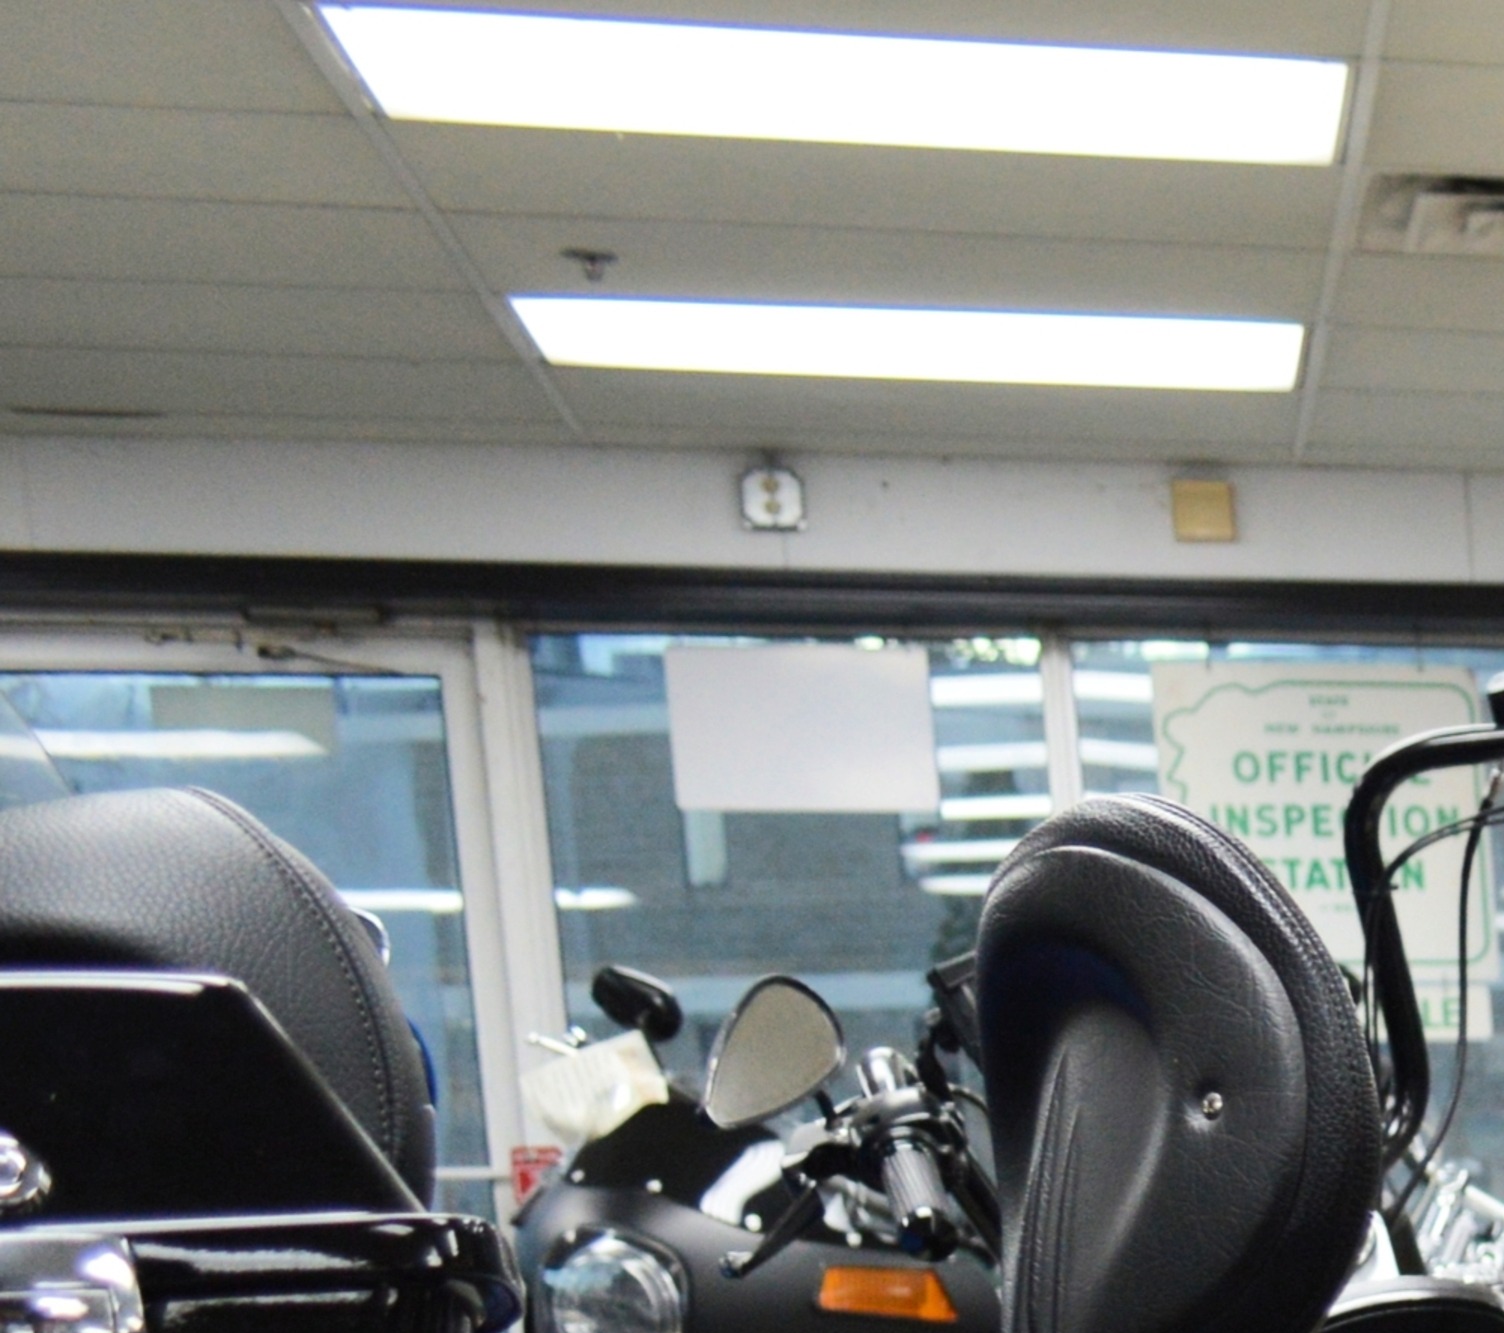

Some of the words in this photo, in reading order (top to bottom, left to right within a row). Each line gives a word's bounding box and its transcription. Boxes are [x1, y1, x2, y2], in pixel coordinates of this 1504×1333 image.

[1264, 723, 1299, 734] NEW
[1312, 723, 1402, 735] HAMPSHIRE
[1232, 751, 1431, 784] OFFICL
[1210, 803, 1460, 839] INSPEION
[1263, 857, 1425, 891] TATN
